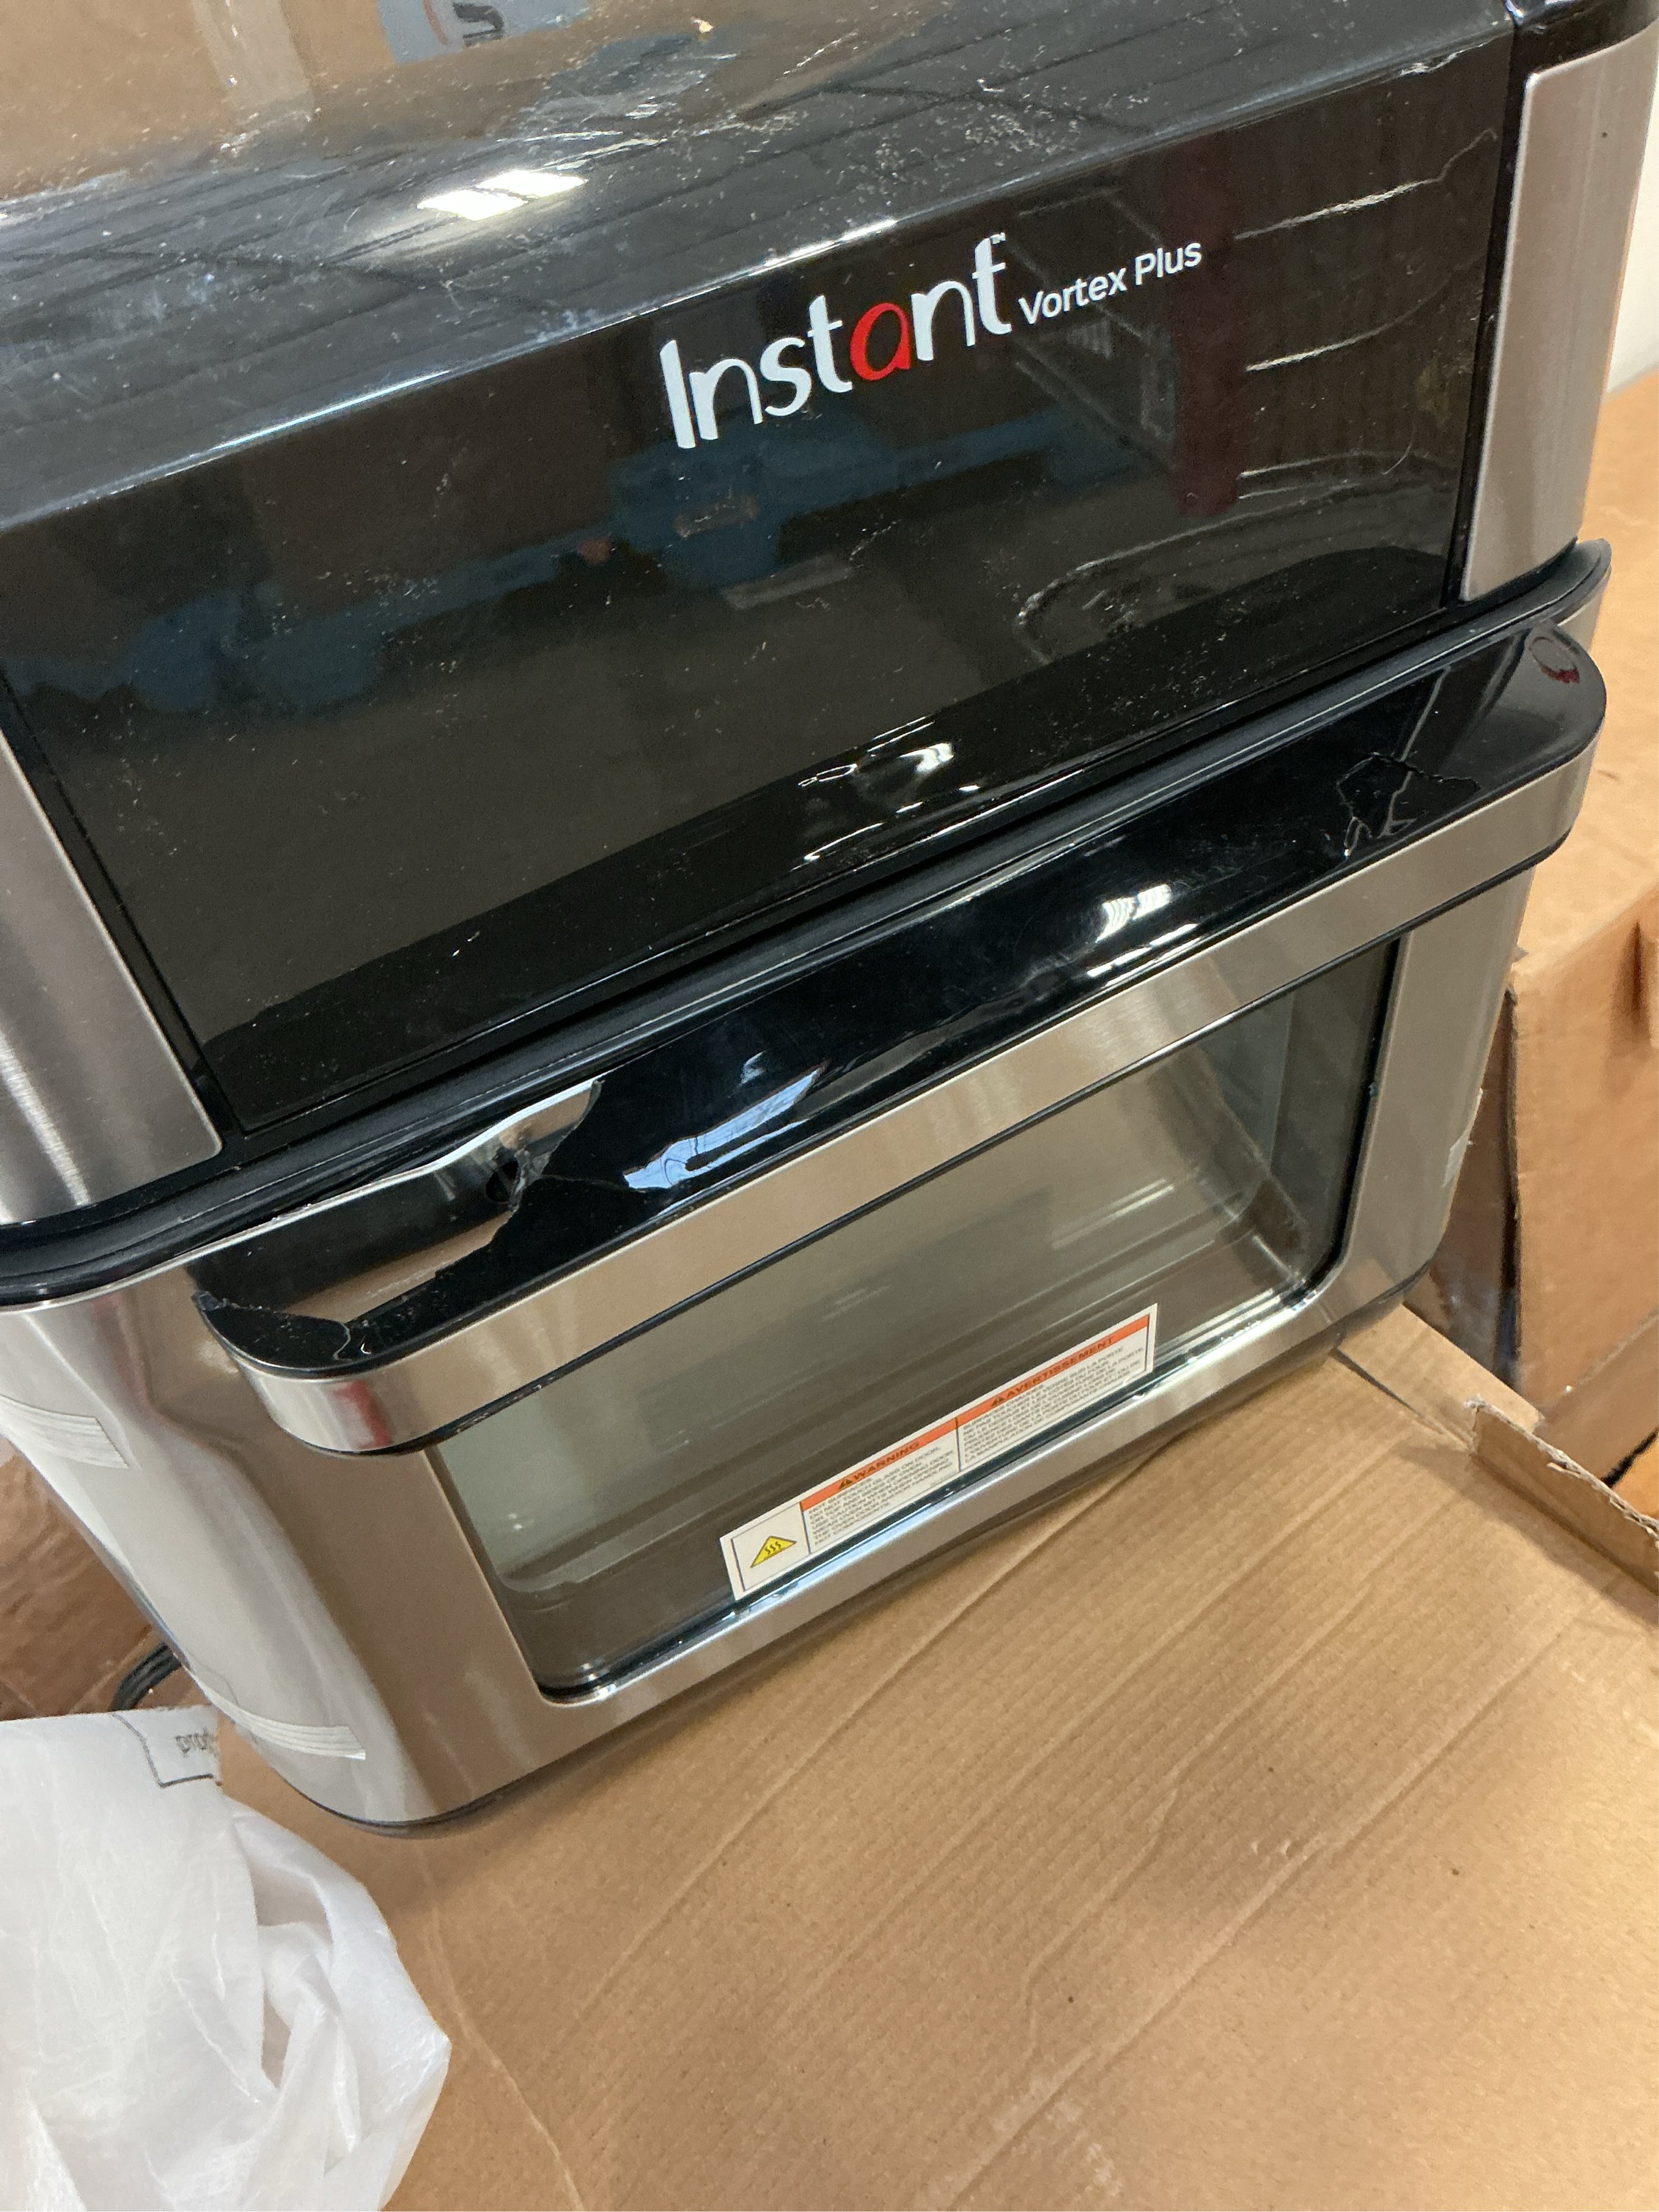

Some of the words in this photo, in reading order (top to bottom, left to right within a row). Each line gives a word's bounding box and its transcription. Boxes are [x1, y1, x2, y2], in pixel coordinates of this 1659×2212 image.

[659, 236, 1012, 449] Instant
[1018, 269, 1127, 326] Vortex
[1134, 242, 1203, 286] Plus
[1006, 1336, 1112, 1398] AVERTISSEMENT
[853, 1440, 920, 1481] WARNING
